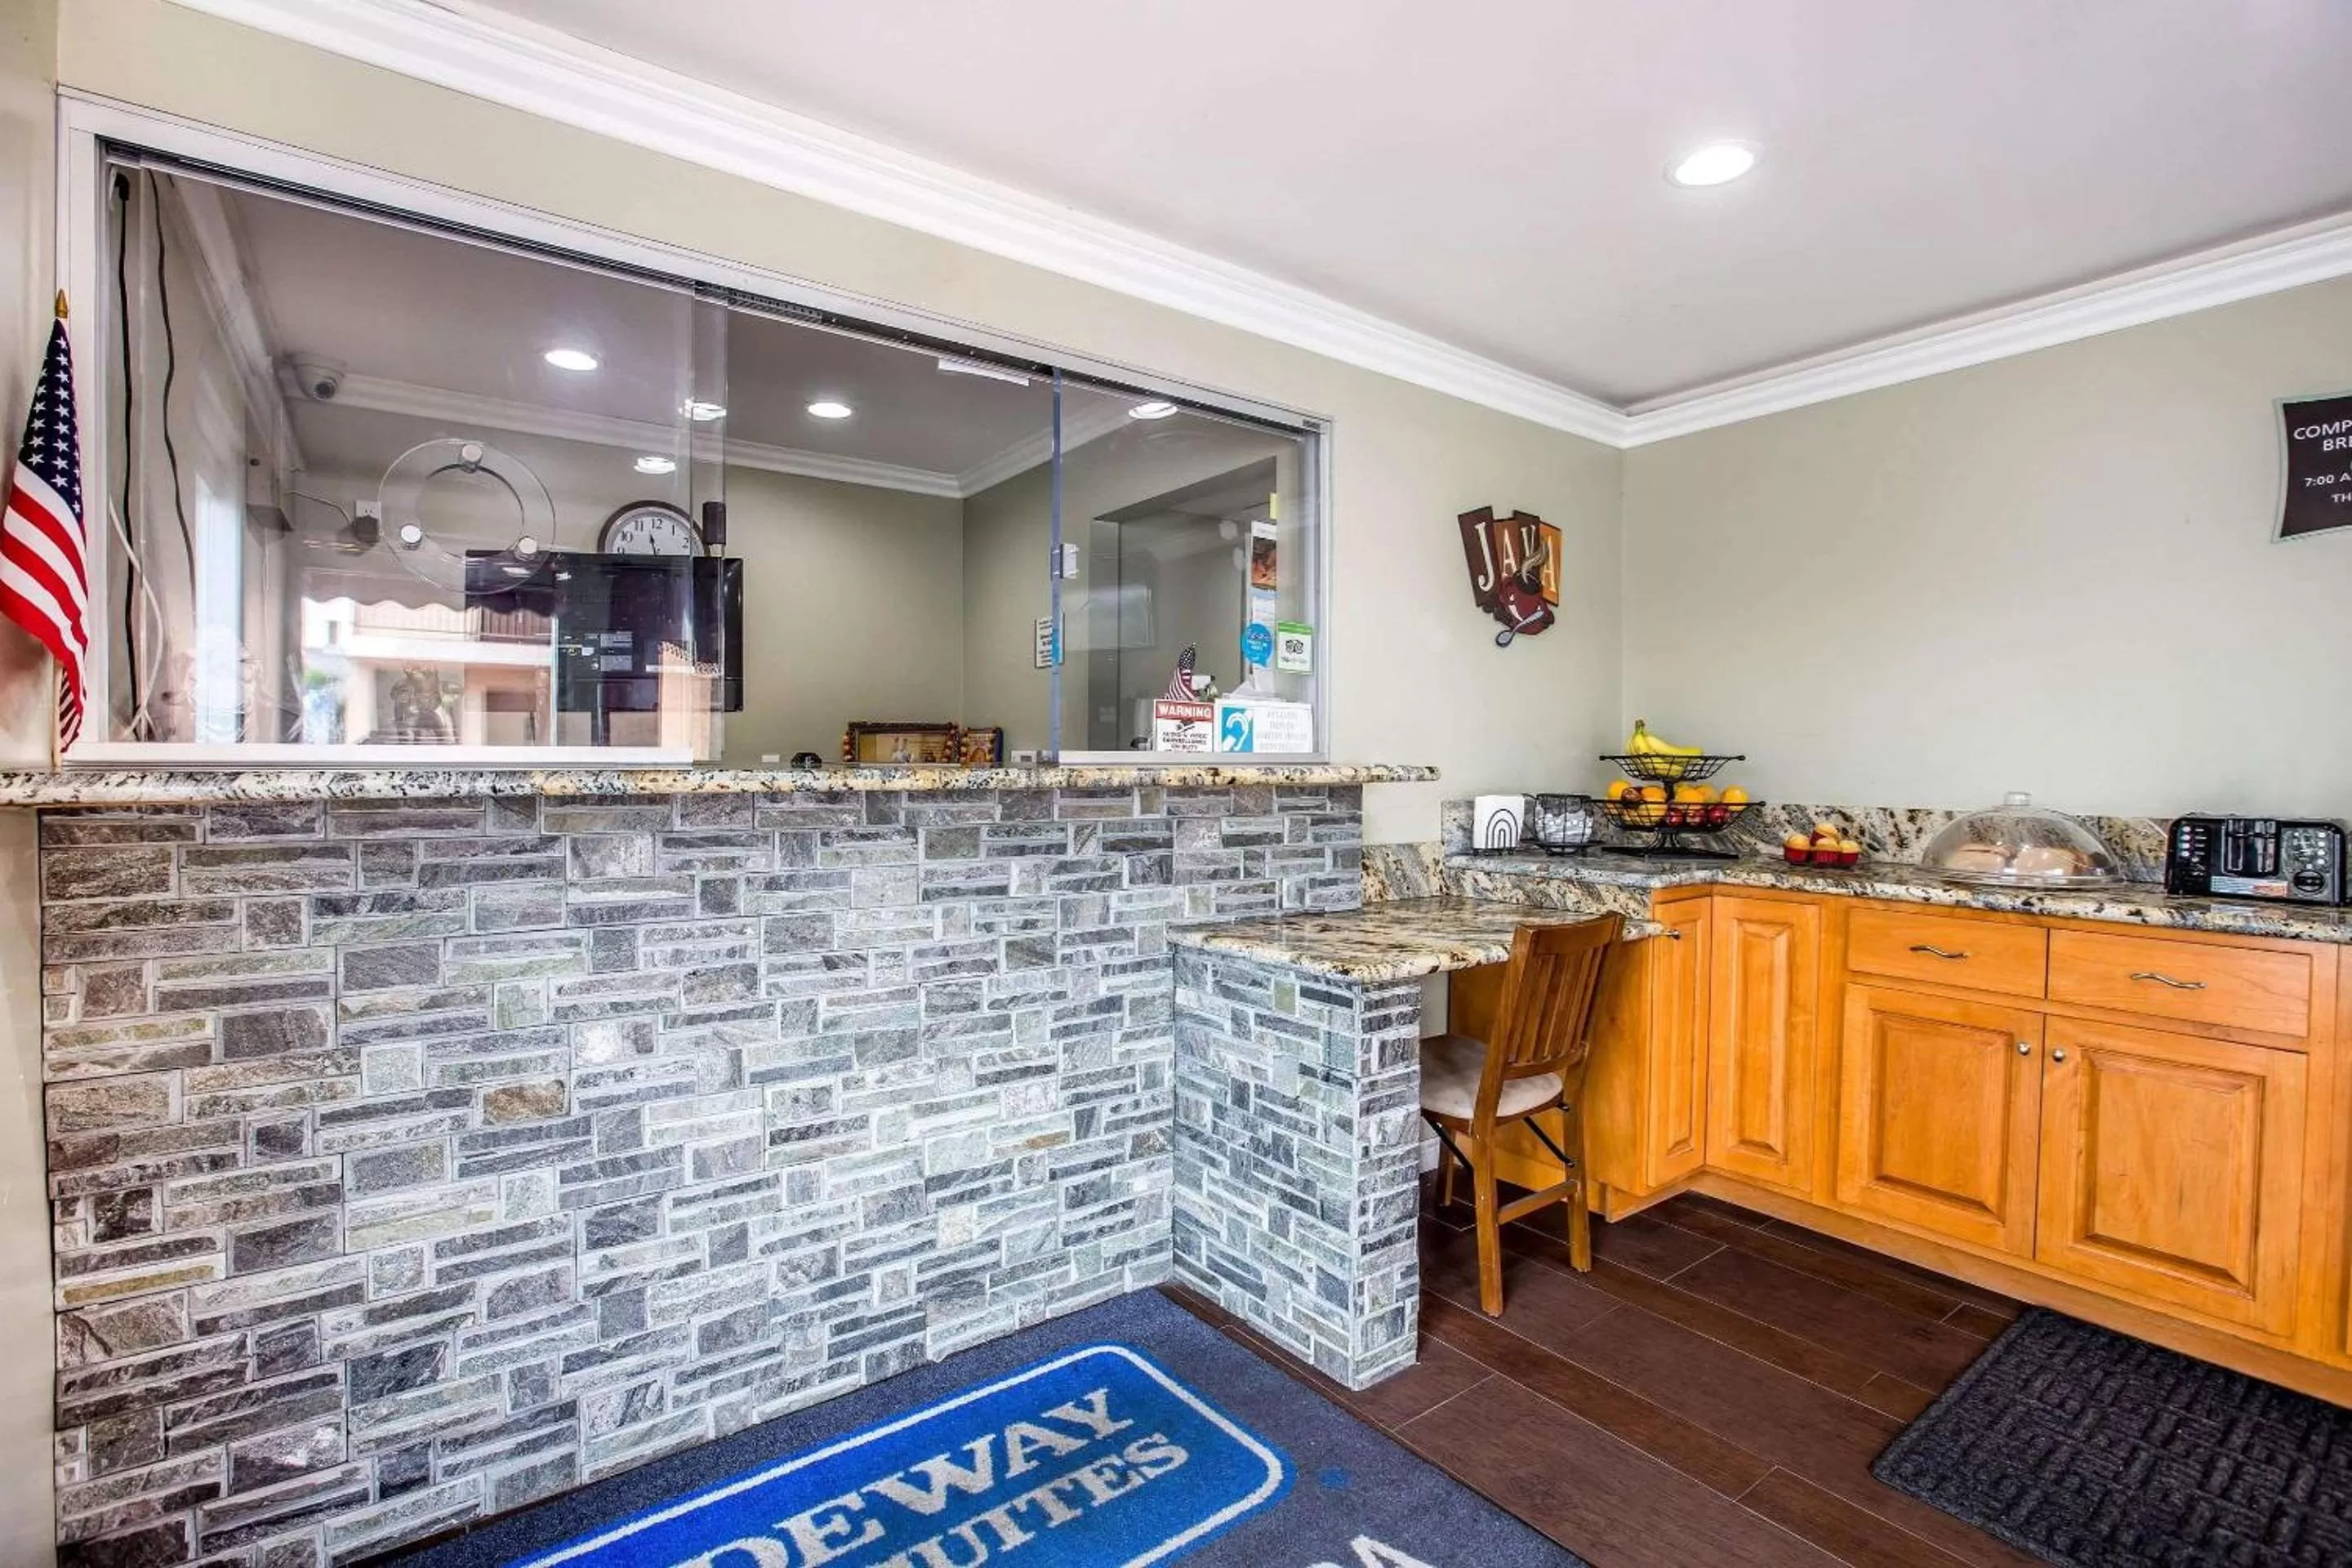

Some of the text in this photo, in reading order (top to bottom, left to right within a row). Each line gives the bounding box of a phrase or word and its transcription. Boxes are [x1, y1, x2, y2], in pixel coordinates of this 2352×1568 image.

[2293, 420, 2352, 440] COMP
[2305, 474, 2335, 487] 7:00
[635, 520, 644, 532] 11
[652, 518, 662, 529] 12
[671, 524, 675, 537] 1
[681, 537, 689, 549] 2
[1474, 521, 1557, 593] JAVA
[1158, 704, 1212, 719] WARNING
[866, 1432, 1189, 1568] UITES
